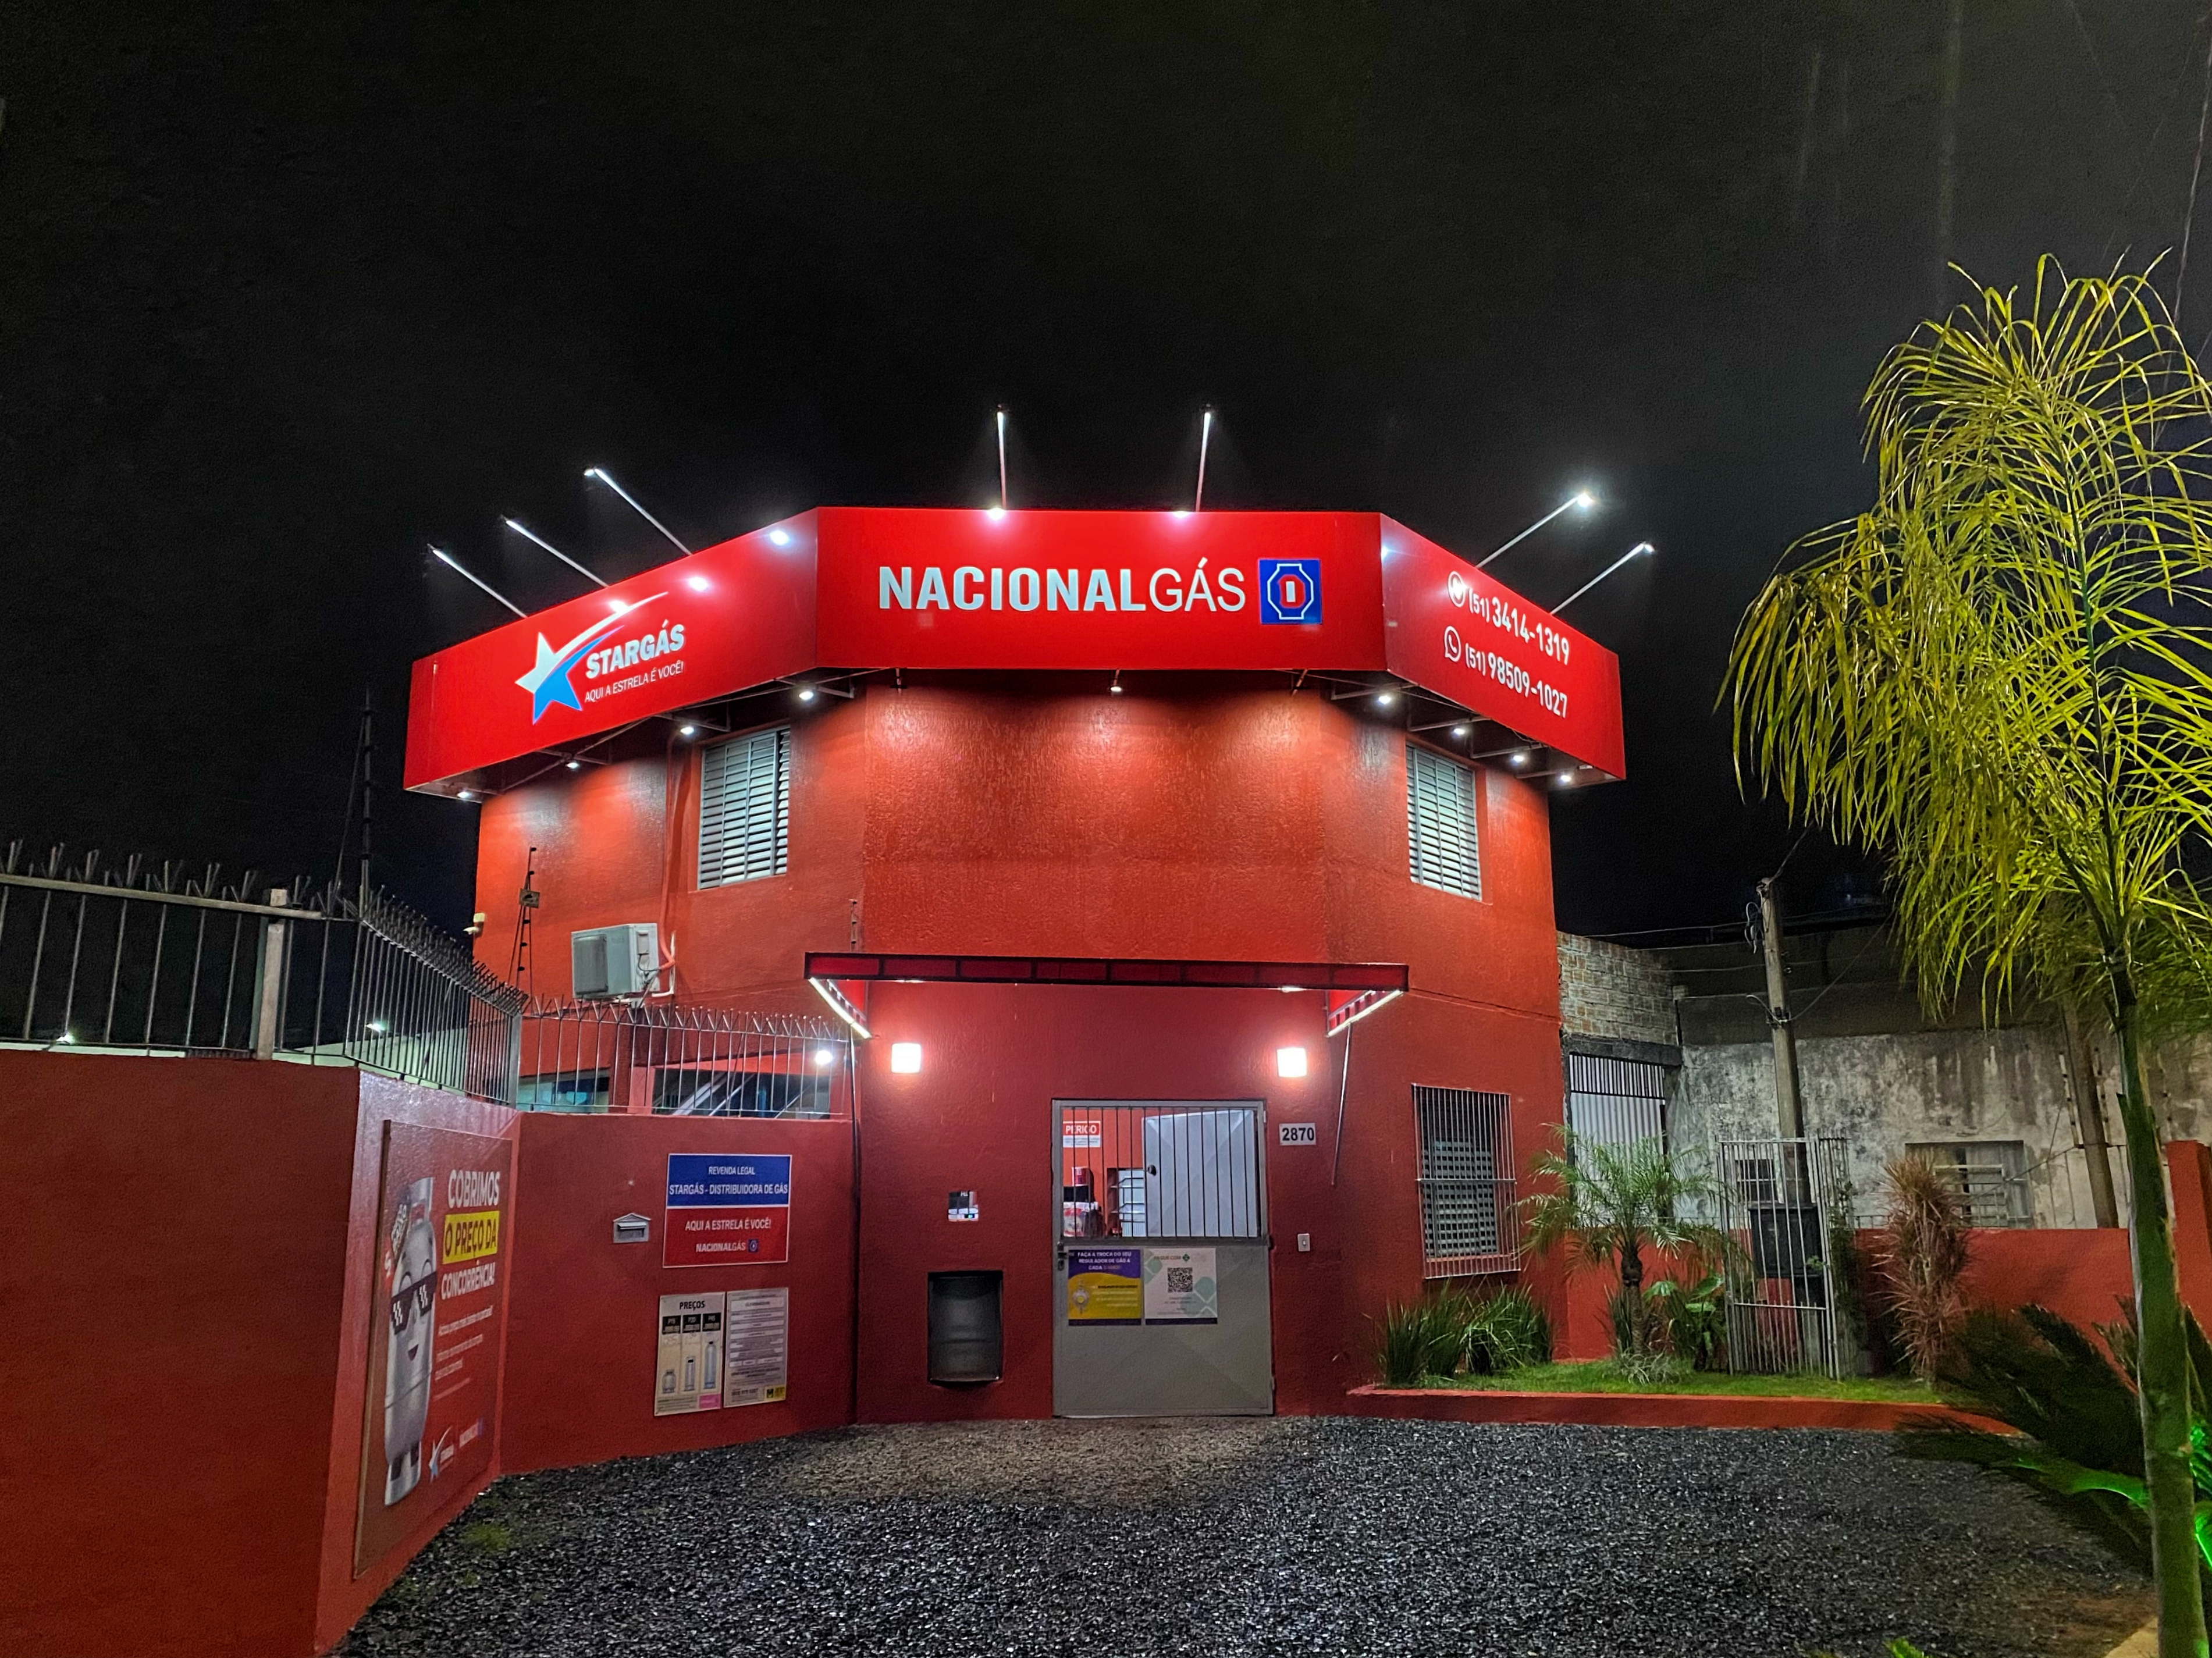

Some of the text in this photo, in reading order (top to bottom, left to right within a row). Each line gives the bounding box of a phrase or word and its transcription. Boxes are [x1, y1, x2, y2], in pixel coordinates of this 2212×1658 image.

[878, 557, 1246, 613] NACIONALGÁS
[1469, 588, 1569, 665] (51) 3414-1319
[585, 619, 685, 679] STARGÁS
[584, 660, 684, 703] AQUI A ESTRELA É VOCÊ!
[1465, 643, 1567, 718] (51) 98509-1027
[1065, 1125, 1097, 1134] PERIGO
[1282, 1127, 1314, 1141] 2870
[448, 1169, 500, 1208] COBRIMOS
[669, 1182, 704, 1195] STARGÁS
[709, 1184, 763, 1194] DISTRIBUIDORA
[764, 1184, 773, 1194] DE
[774, 1182, 788, 1194] GÁS
[708, 1166, 736, 1175] REVENDA
[445, 1223, 453, 1257] O
[455, 1219, 484, 1257] PREÇO
[485, 1219, 496, 1250] DA
[685, 1217, 771, 1231] AQUI A ESTRELA É VOCÊ!
[696, 1241, 746, 1253] NACIONALGÁS
[441, 1260, 496, 1300] CONCORRÊNCIA!
[680, 1301, 705, 1311] PREÇOS
